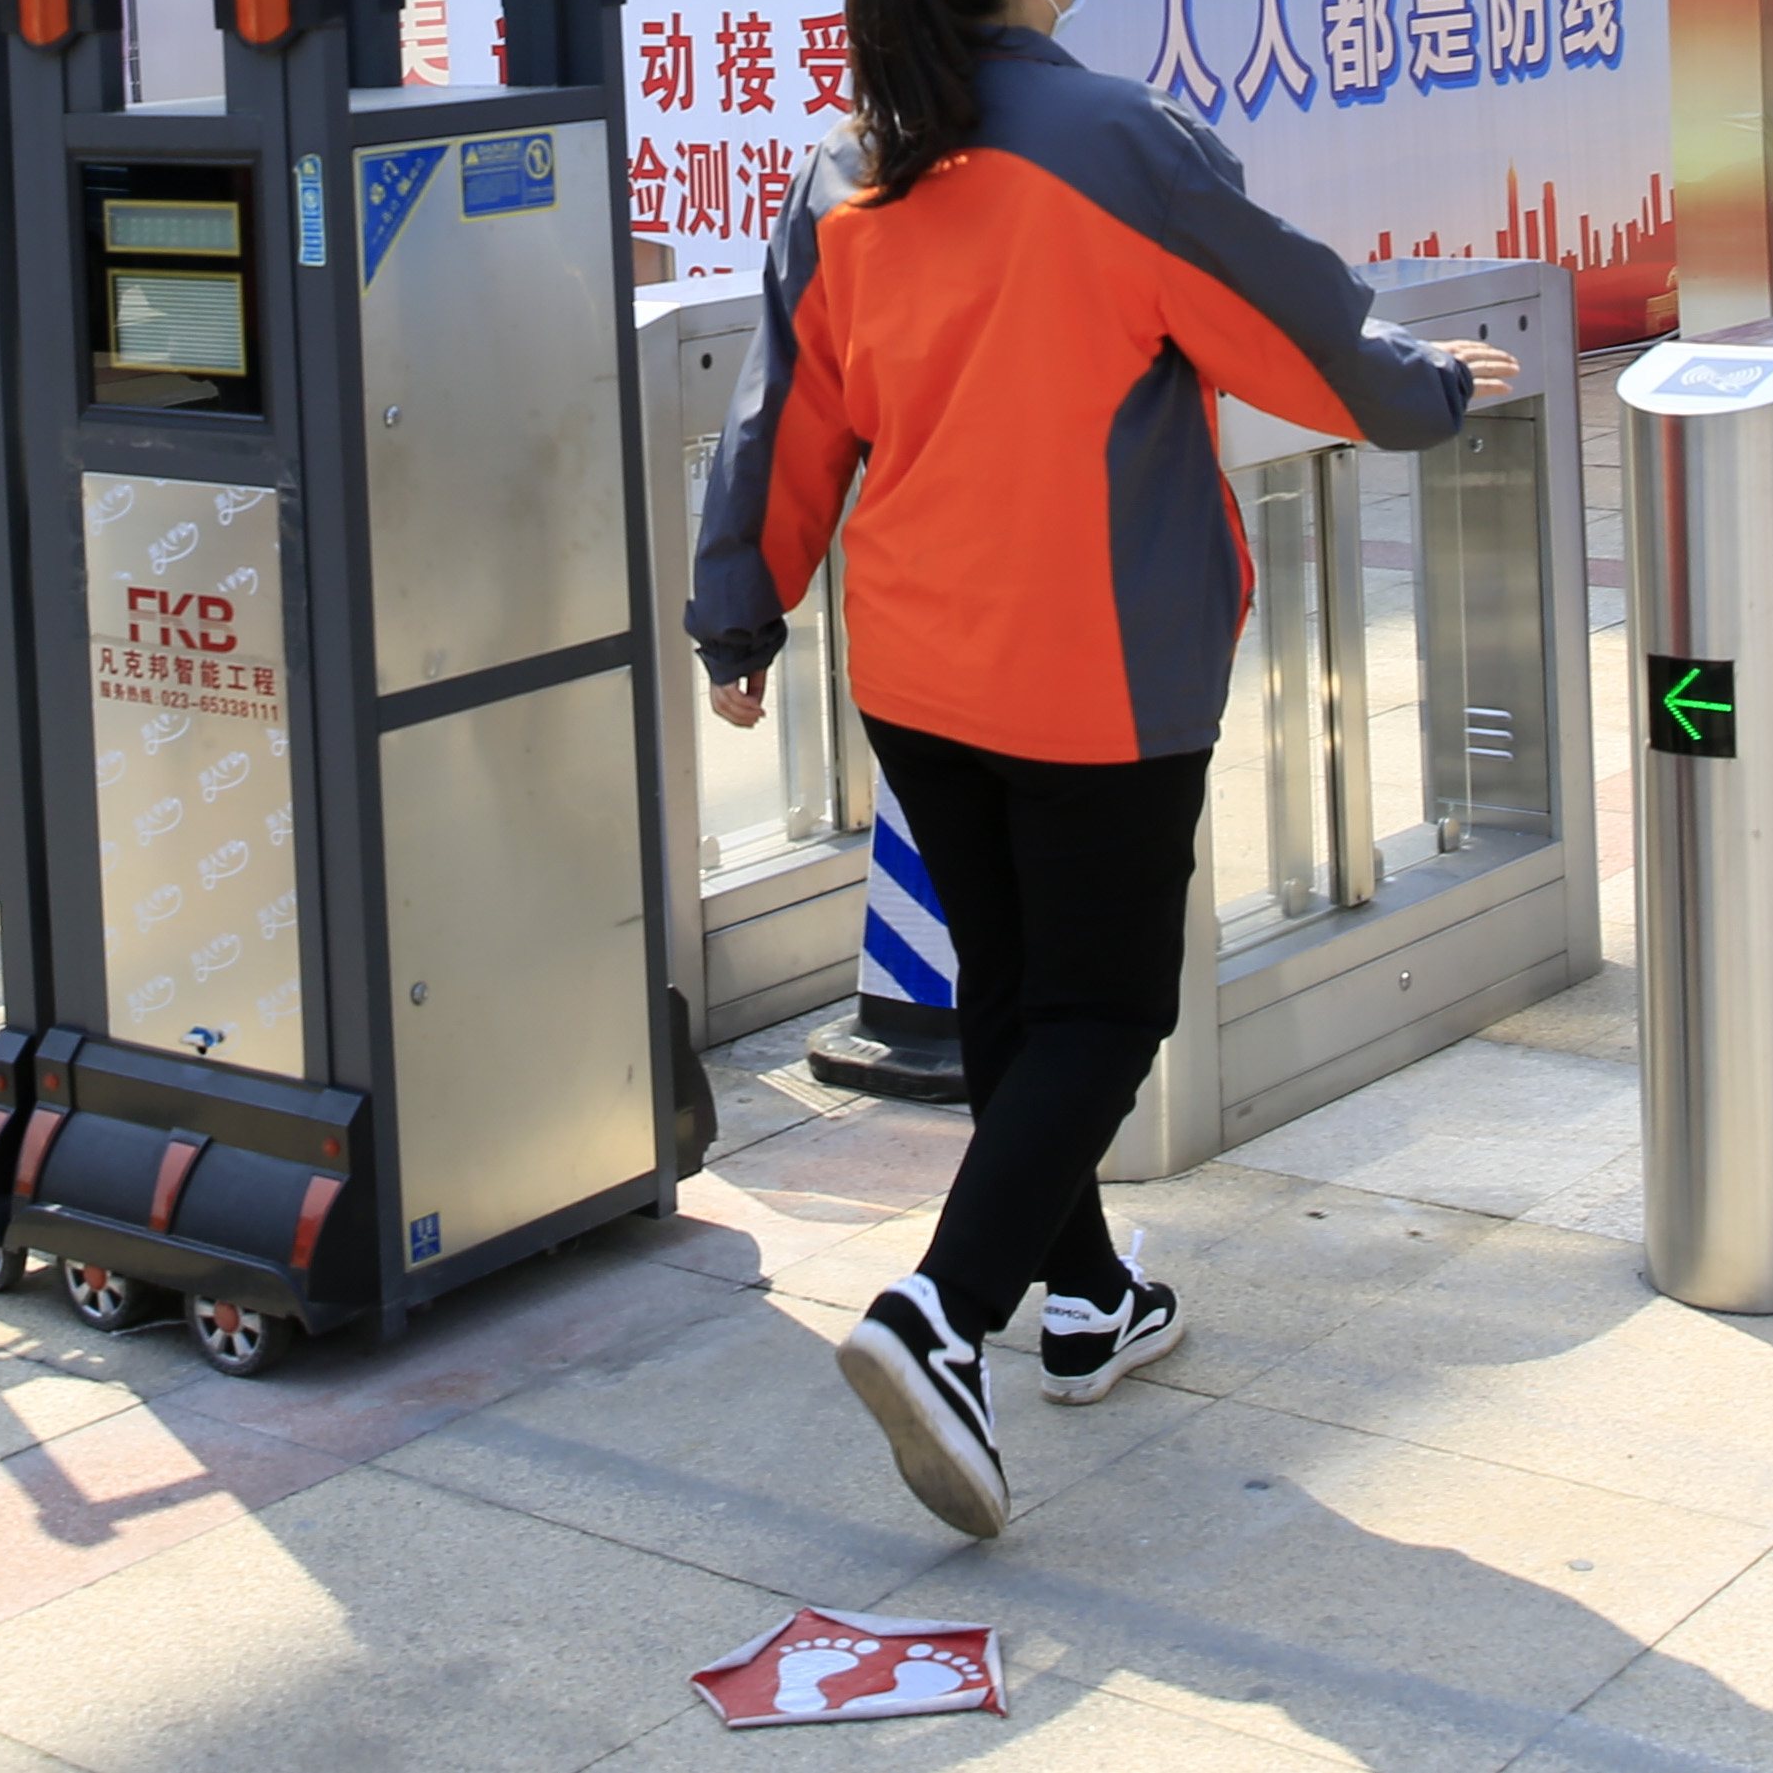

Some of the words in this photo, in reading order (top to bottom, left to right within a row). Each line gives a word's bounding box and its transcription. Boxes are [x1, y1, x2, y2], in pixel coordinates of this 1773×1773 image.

[127, 587, 238, 654] FKB
[99, 647, 276, 697] 凡克邦智能工程
